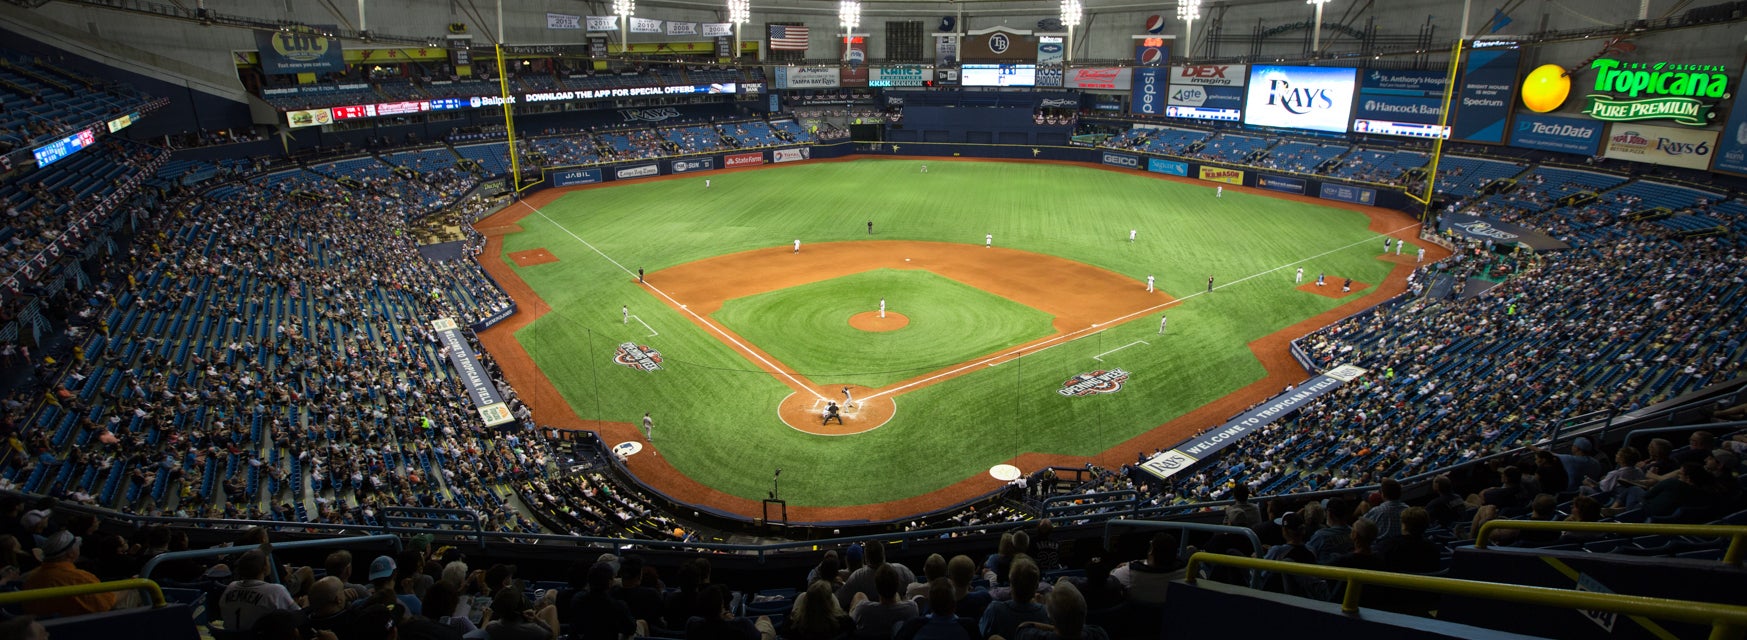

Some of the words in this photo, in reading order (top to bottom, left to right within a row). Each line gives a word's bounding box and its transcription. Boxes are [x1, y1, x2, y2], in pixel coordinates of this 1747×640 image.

[992, 36, 1006, 50] TB
[1037, 68, 1062, 76] ROSE
[1181, 65, 1229, 78] DEX
[1623, 62, 1646, 70] THE
[1668, 63, 1726, 72] ORIGINAL
[1190, 77, 1232, 85] imaging
[1390, 76, 1423, 85] Anthony's
[1591, 58, 1728, 98] Tropicana
[525, 91, 574, 102] DOWNLOAD
[574, 90, 592, 100] THE
[594, 89, 610, 99] APP
[612, 88, 629, 98] FOR
[630, 86, 664, 96] SPECIAL
[664, 85, 695, 94] OFFERS
[1142, 71, 1156, 114] pepsi
[1183, 89, 1202, 100] gte
[1265, 79, 1333, 114] RAYS
[1376, 102, 1418, 113] Hancock
[1463, 97, 1503, 107] Spectrum
[1592, 101, 1629, 117] PURE
[1629, 101, 1700, 117] PREMIUM
[622, 107, 681, 122] RAYS
[1656, 137, 1694, 156] RAYS
[1694, 141, 1709, 156] 6
[1104, 154, 1137, 166] GEICO
[1216, 171, 1240, 179] MASON
[443, 329, 463, 352] WELCOME
[459, 356, 482, 388] TROPICANA
[476, 387, 494, 405] FIELD
[1058, 376, 1104, 396] OPENING
[1096, 367, 1123, 381] WEEK
[1147, 454, 1186, 472] RAYS
[1187, 422, 1246, 455] WELCOME
[1241, 416, 1260, 428] TO
[1256, 391, 1312, 420] TROPICANA
[1310, 377, 1338, 393] FIELD
[236, 608, 241, 629] 1
